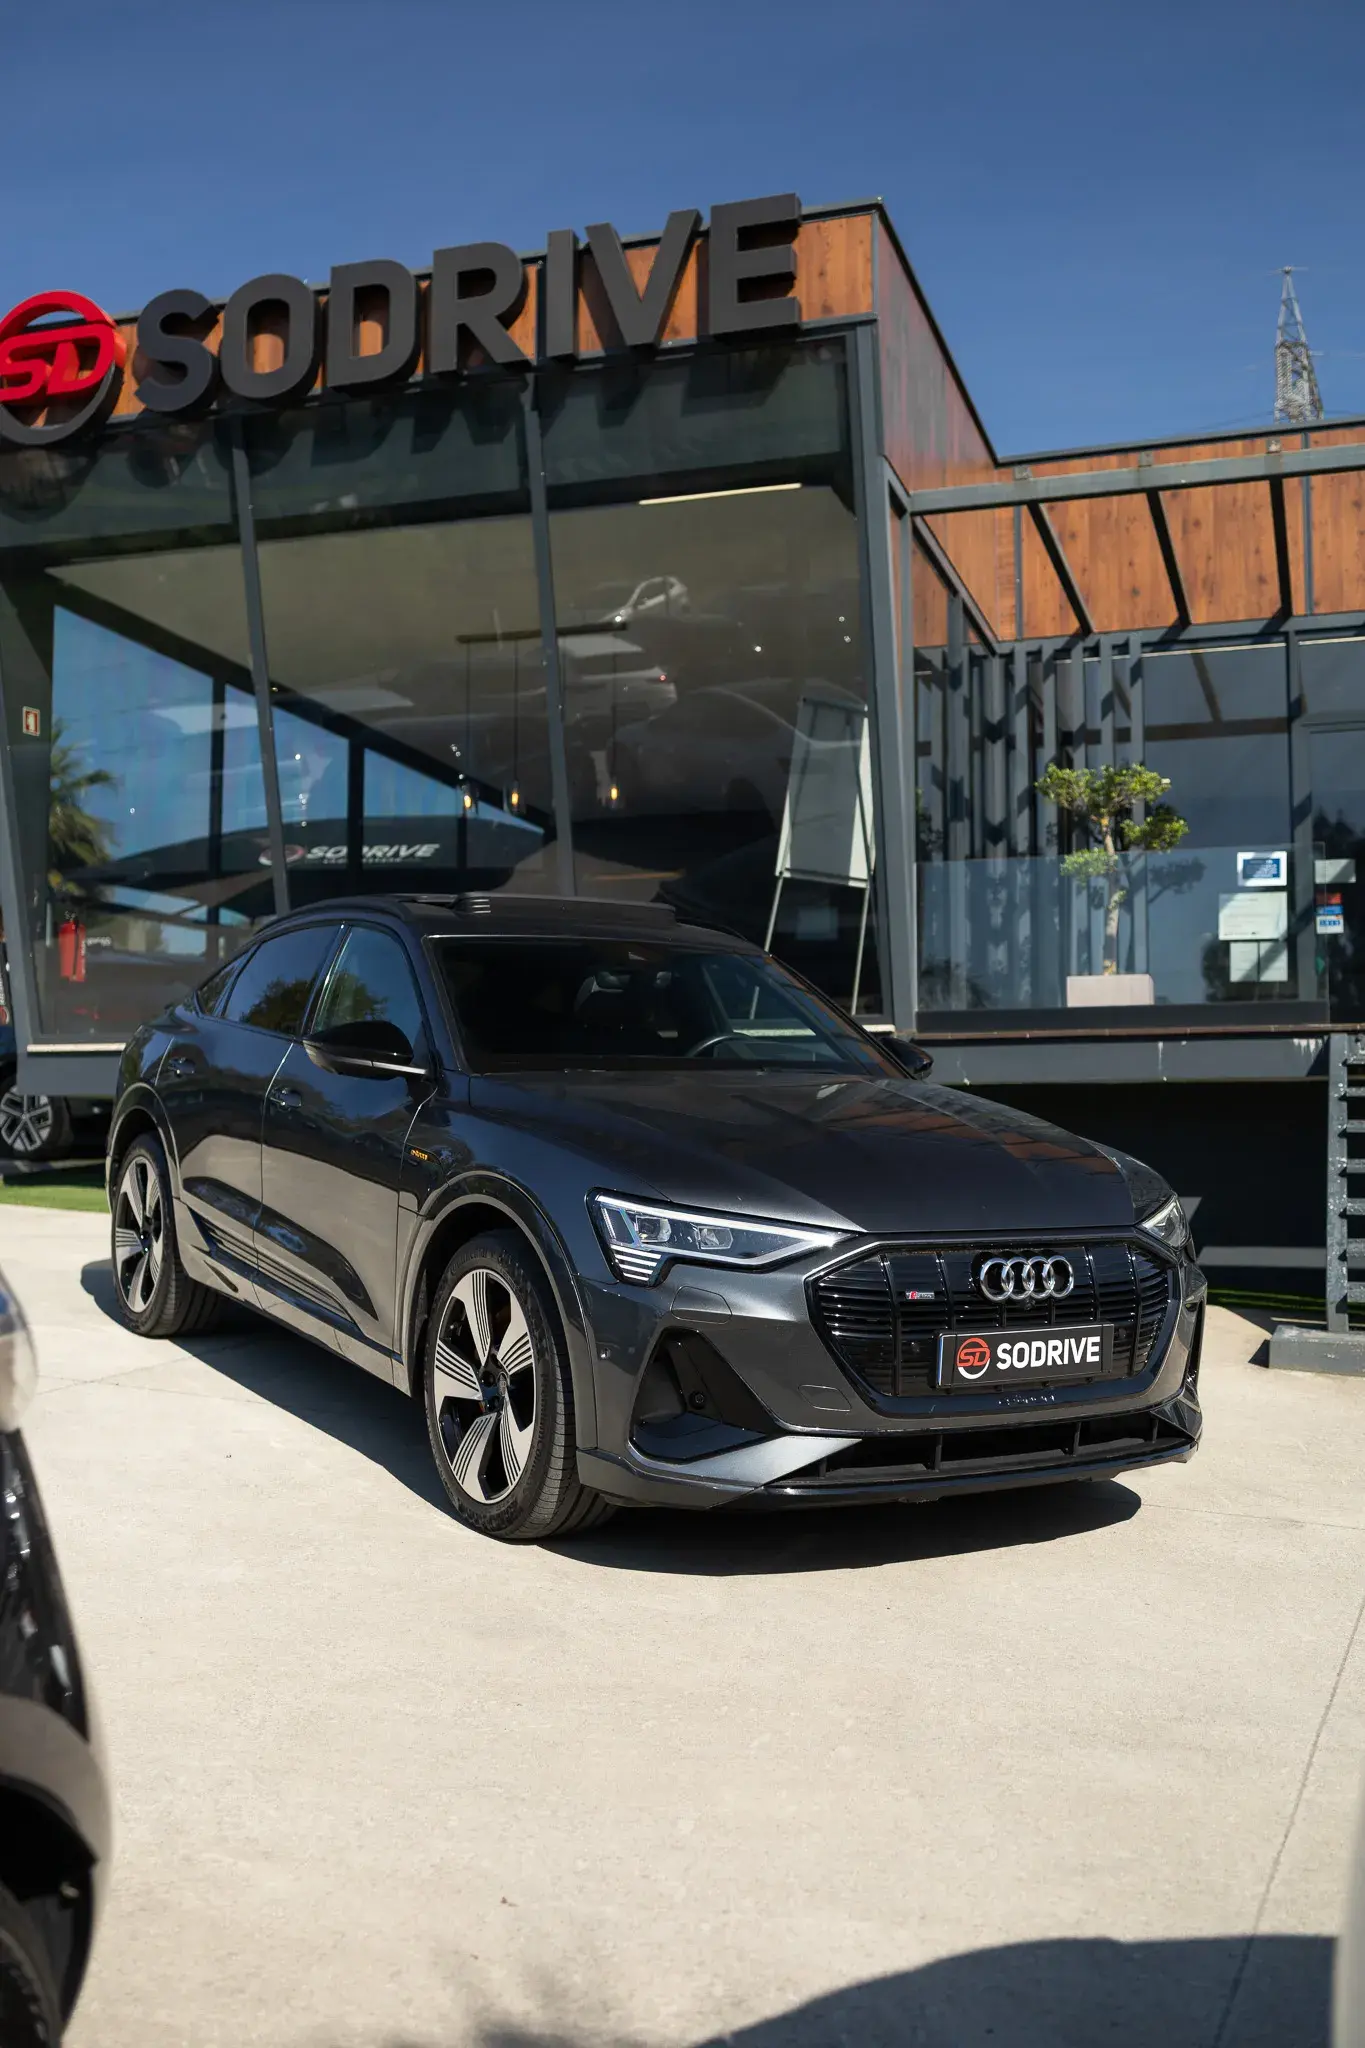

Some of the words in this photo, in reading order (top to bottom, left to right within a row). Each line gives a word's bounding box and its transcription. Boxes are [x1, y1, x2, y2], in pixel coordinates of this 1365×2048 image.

[134, 192, 804, 414] SODRIVE
[306, 843, 441, 860] SORIVE
[996, 1335, 1101, 1371] SODRIVE
